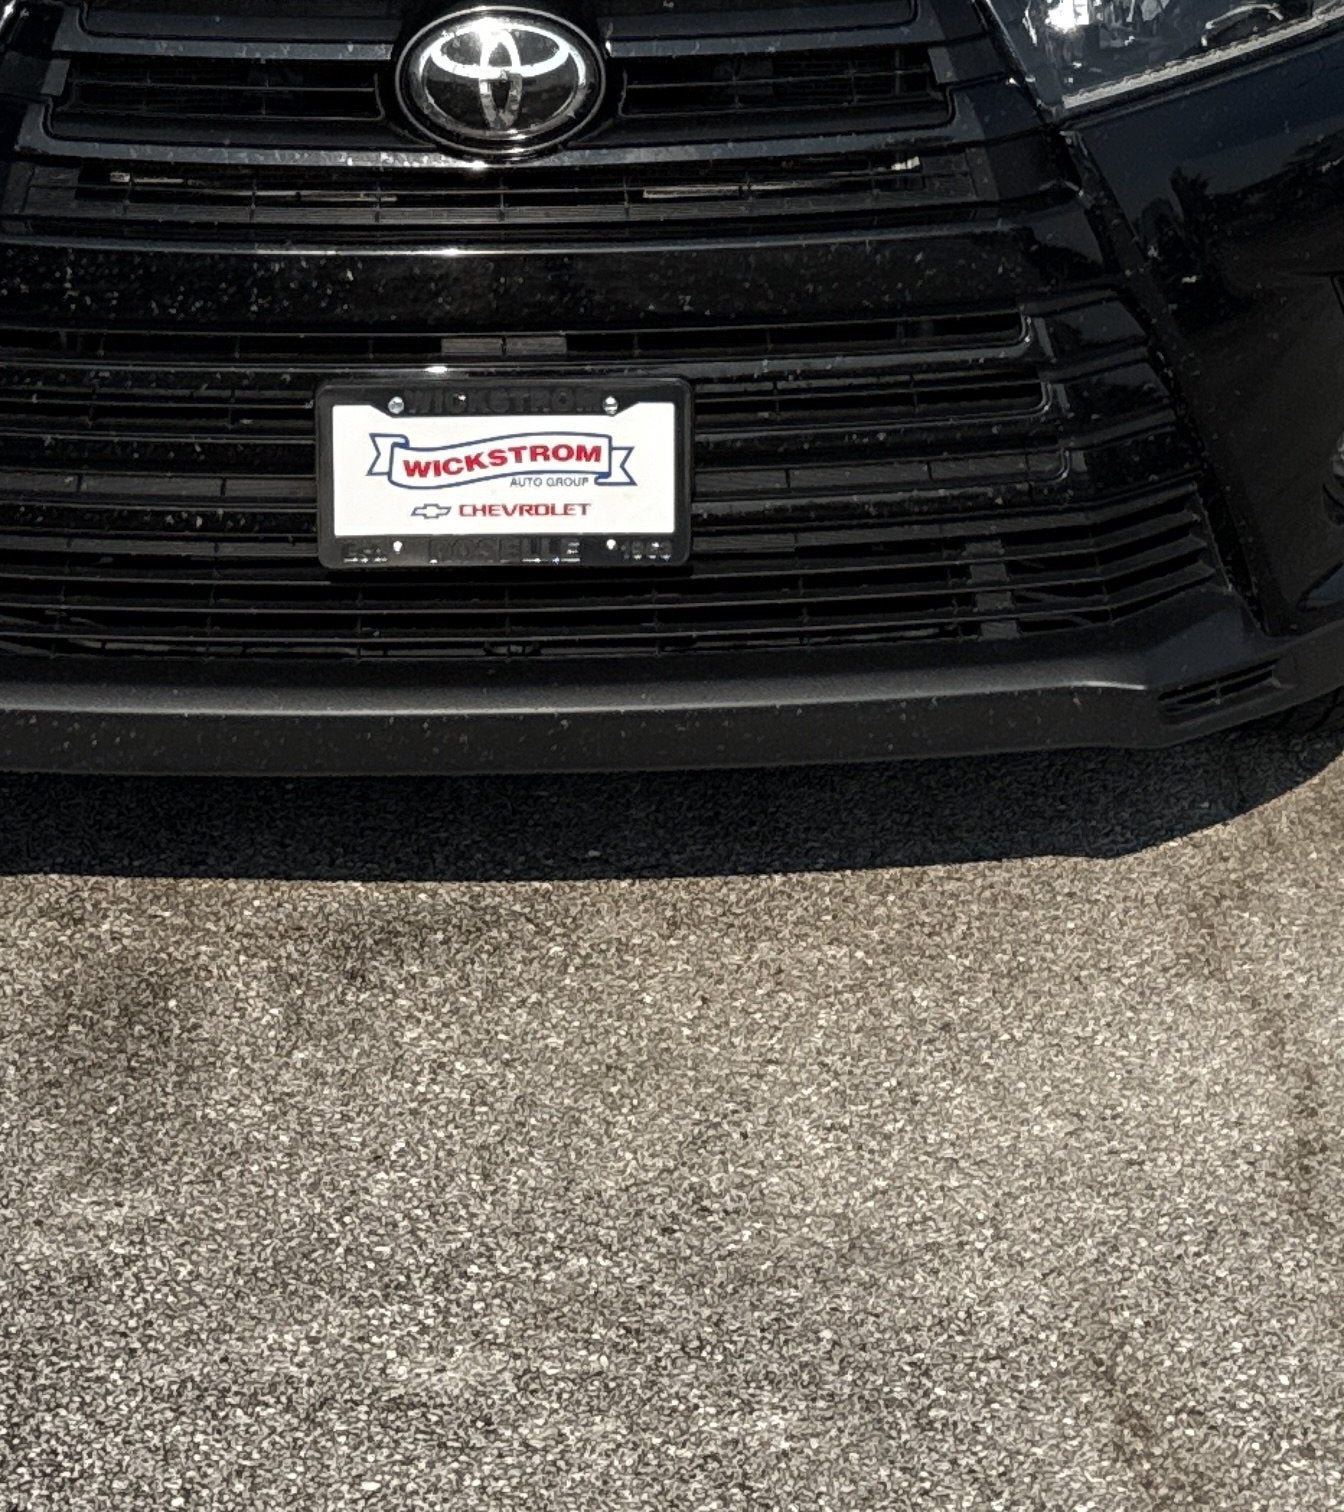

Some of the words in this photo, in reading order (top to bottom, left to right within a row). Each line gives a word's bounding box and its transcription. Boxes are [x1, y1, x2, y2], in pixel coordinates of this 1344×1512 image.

[403, 444, 602, 478] WICKSTROM
[509, 476, 543, 488] AUTO
[546, 476, 589, 488] GROUP
[458, 502, 593, 518] CHEVROLET
